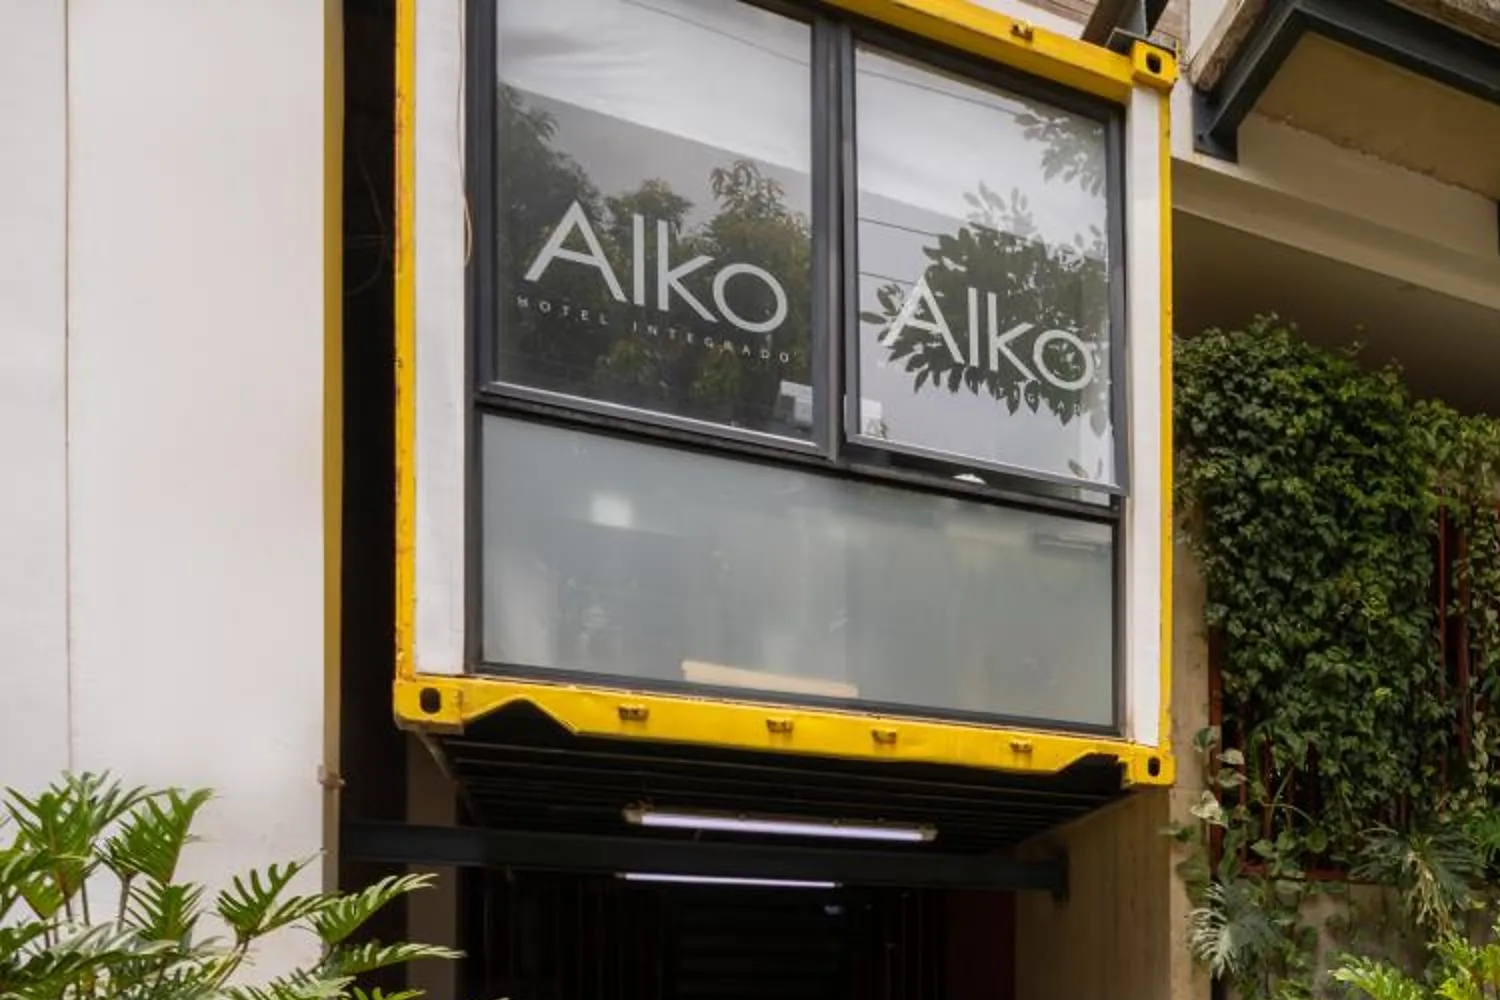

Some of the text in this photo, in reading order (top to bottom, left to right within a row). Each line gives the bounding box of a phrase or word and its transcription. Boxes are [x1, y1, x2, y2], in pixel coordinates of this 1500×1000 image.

[516, 295, 608, 325] HOTEL
[524, 200, 788, 333] Alko
[882, 276, 1094, 391] Alko
